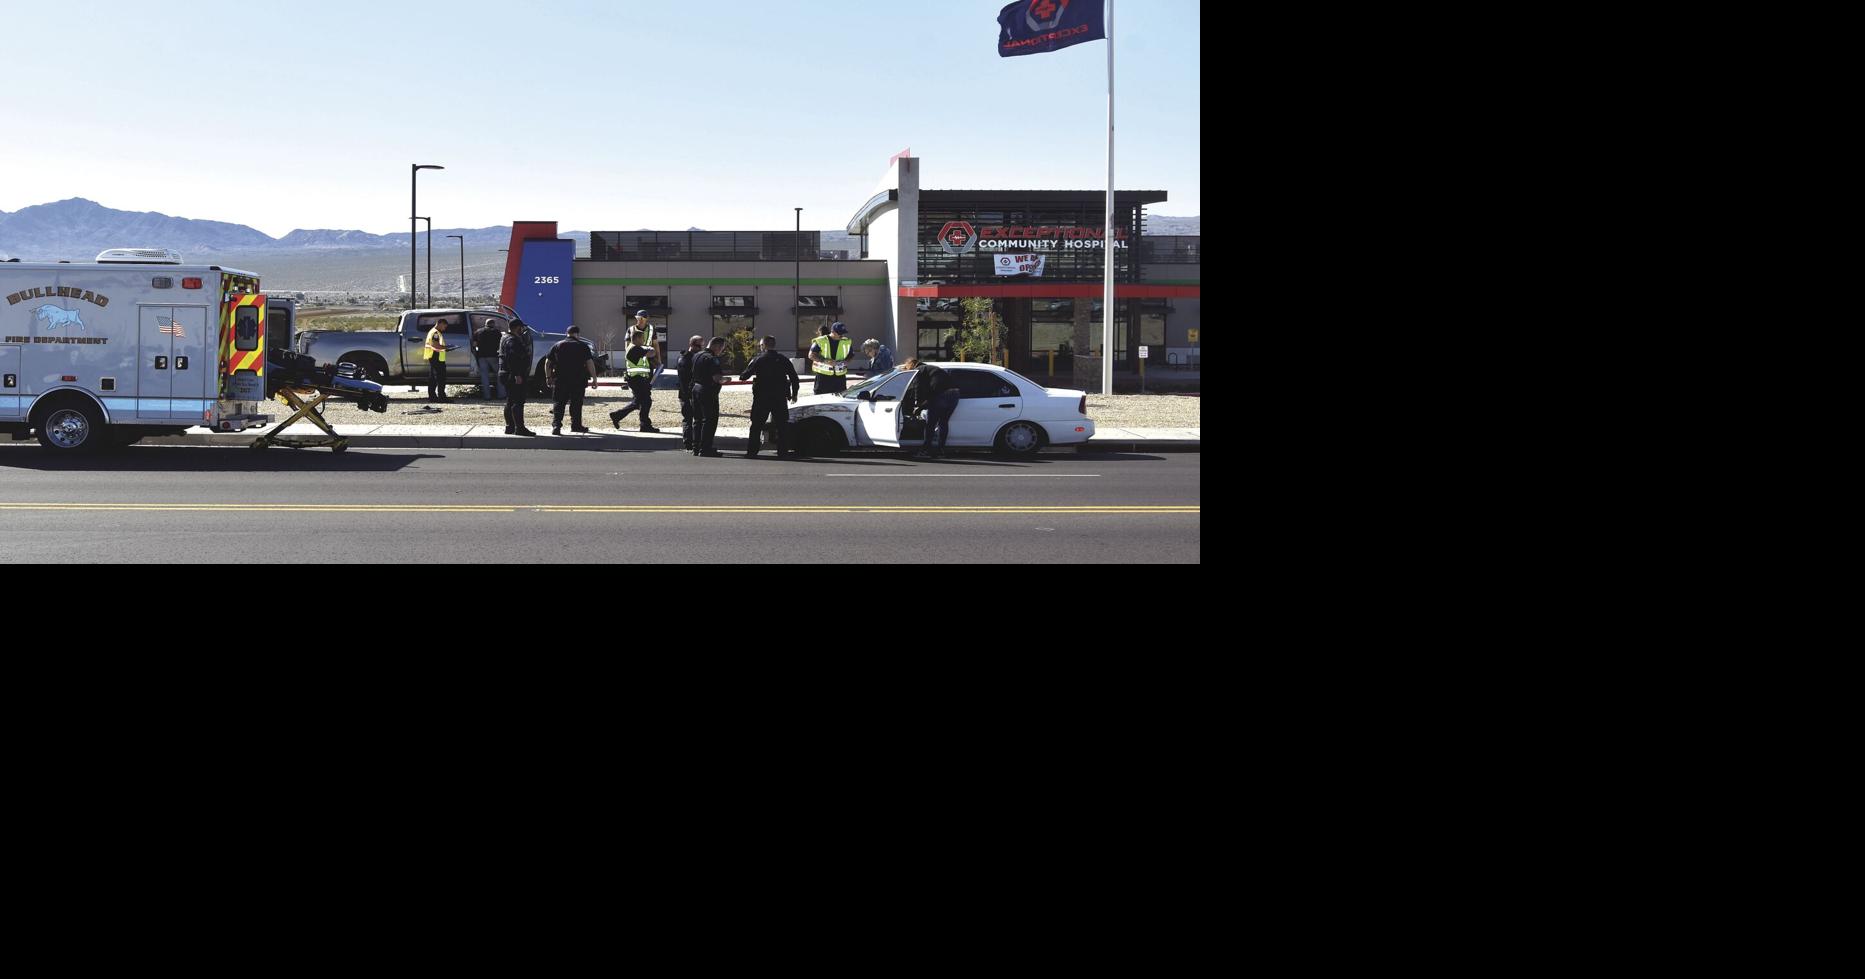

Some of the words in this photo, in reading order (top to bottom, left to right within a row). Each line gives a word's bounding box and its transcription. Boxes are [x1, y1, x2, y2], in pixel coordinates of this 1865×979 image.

[978, 239, 1058, 249] COMMUNITY
[1064, 239, 1128, 249] HOSPIAL
[534, 276, 559, 284] 2365
[6, 286, 109, 307] BULLHEAD
[33, 336, 108, 345] DEPARTMENT
